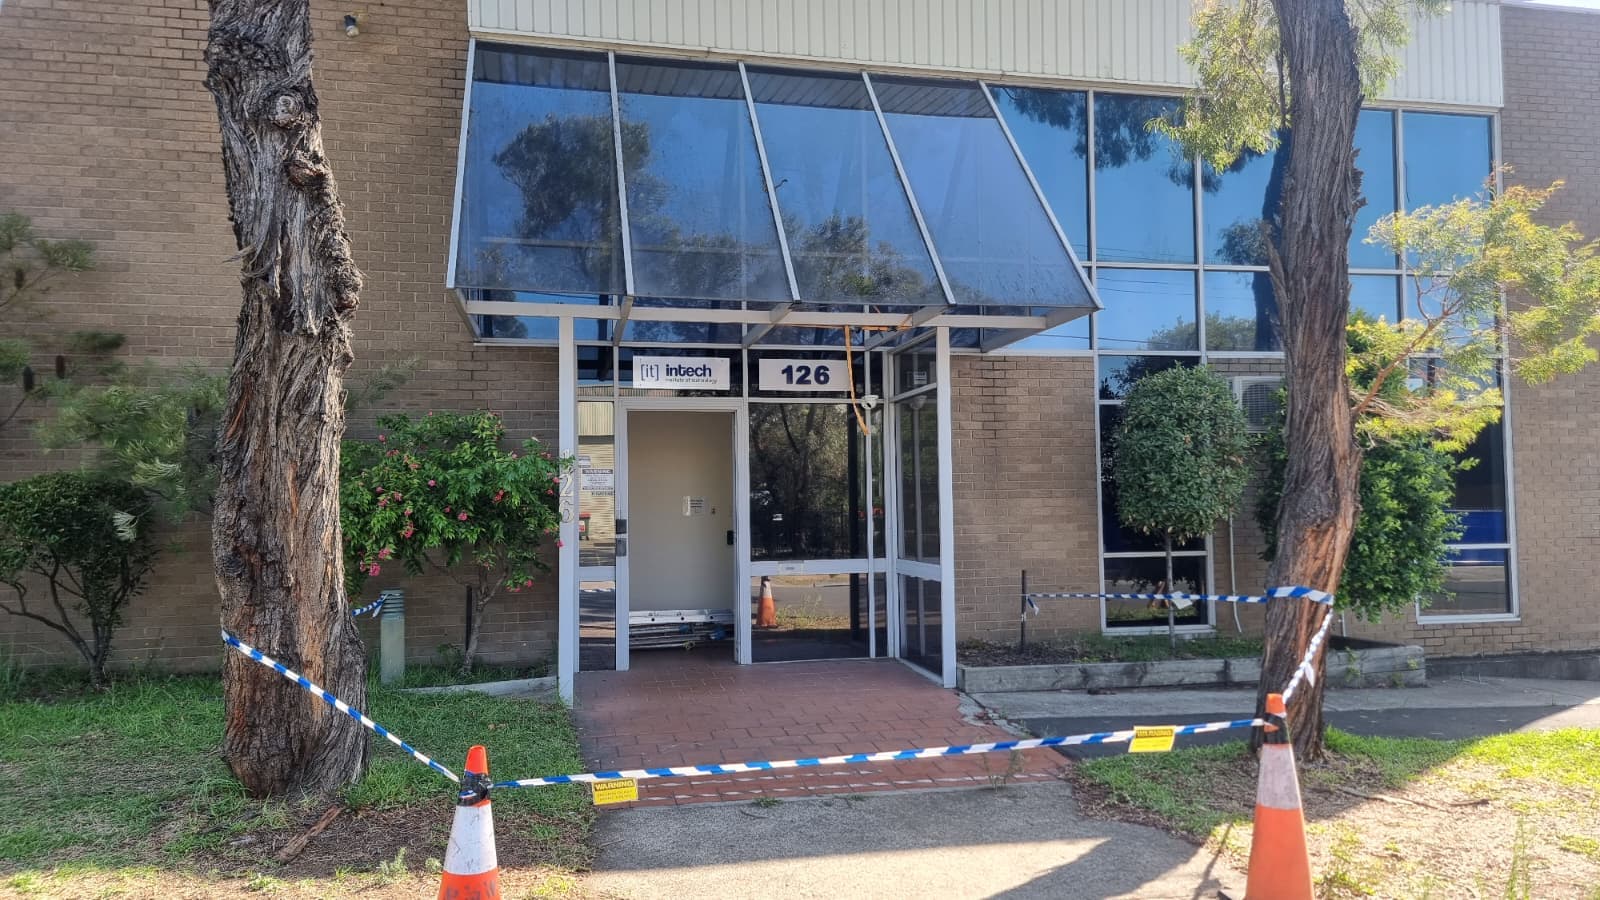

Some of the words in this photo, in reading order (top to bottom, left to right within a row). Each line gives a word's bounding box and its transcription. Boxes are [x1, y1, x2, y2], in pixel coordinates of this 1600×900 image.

[665, 364, 712, 377] intech
[781, 365, 830, 385] 126
[595, 780, 633, 790] WARNING
